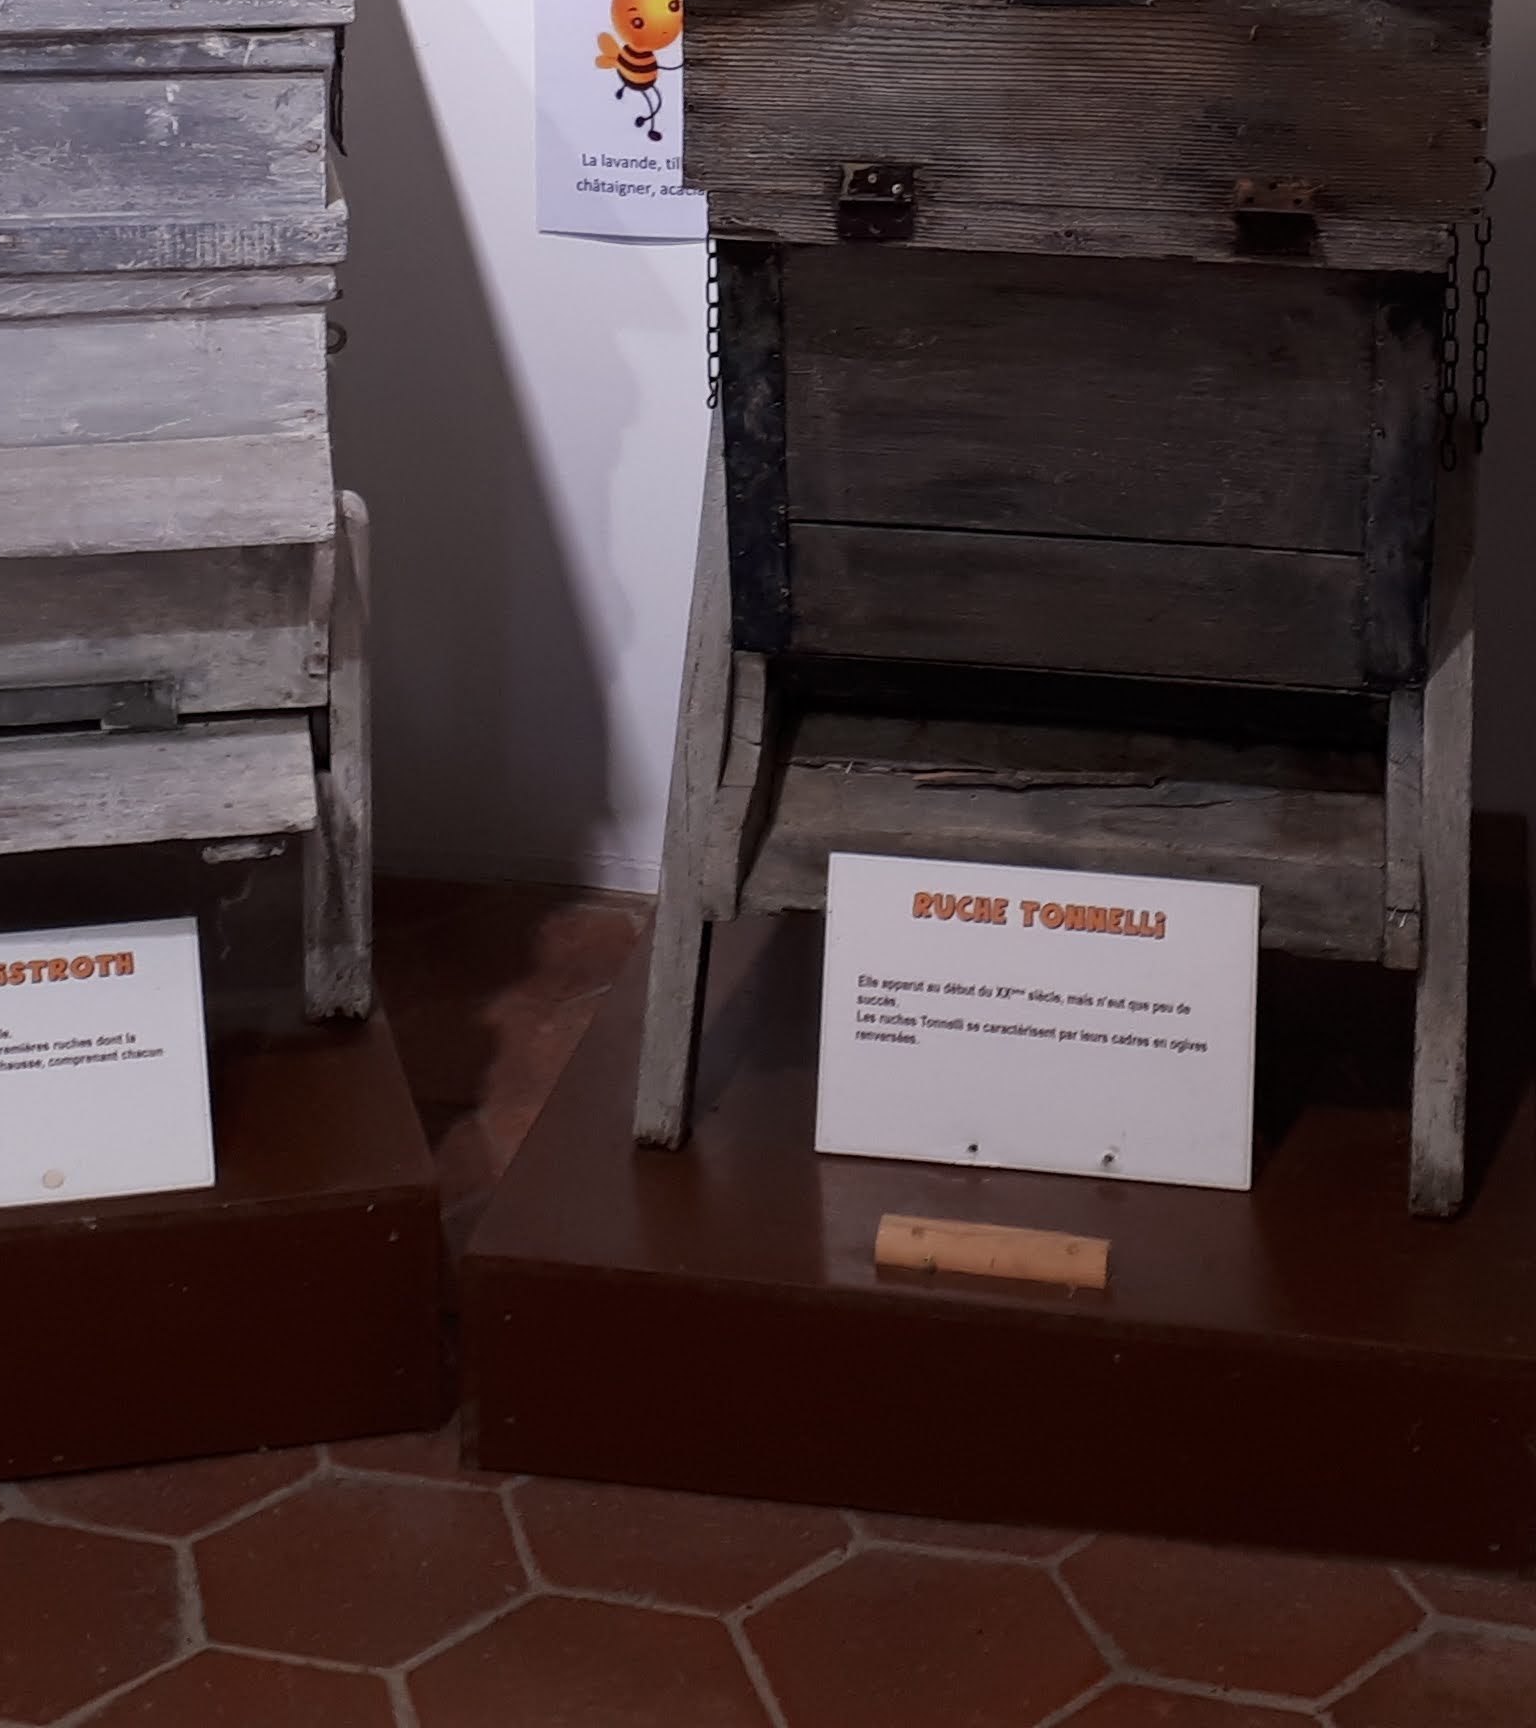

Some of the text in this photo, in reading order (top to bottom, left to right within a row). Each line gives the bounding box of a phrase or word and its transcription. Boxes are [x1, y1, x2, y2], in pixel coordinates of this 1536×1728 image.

[582, 153, 681, 172] La lavande, til
[576, 178, 656, 197] châtaigner,
[912, 891, 1009, 926] RUCHE
